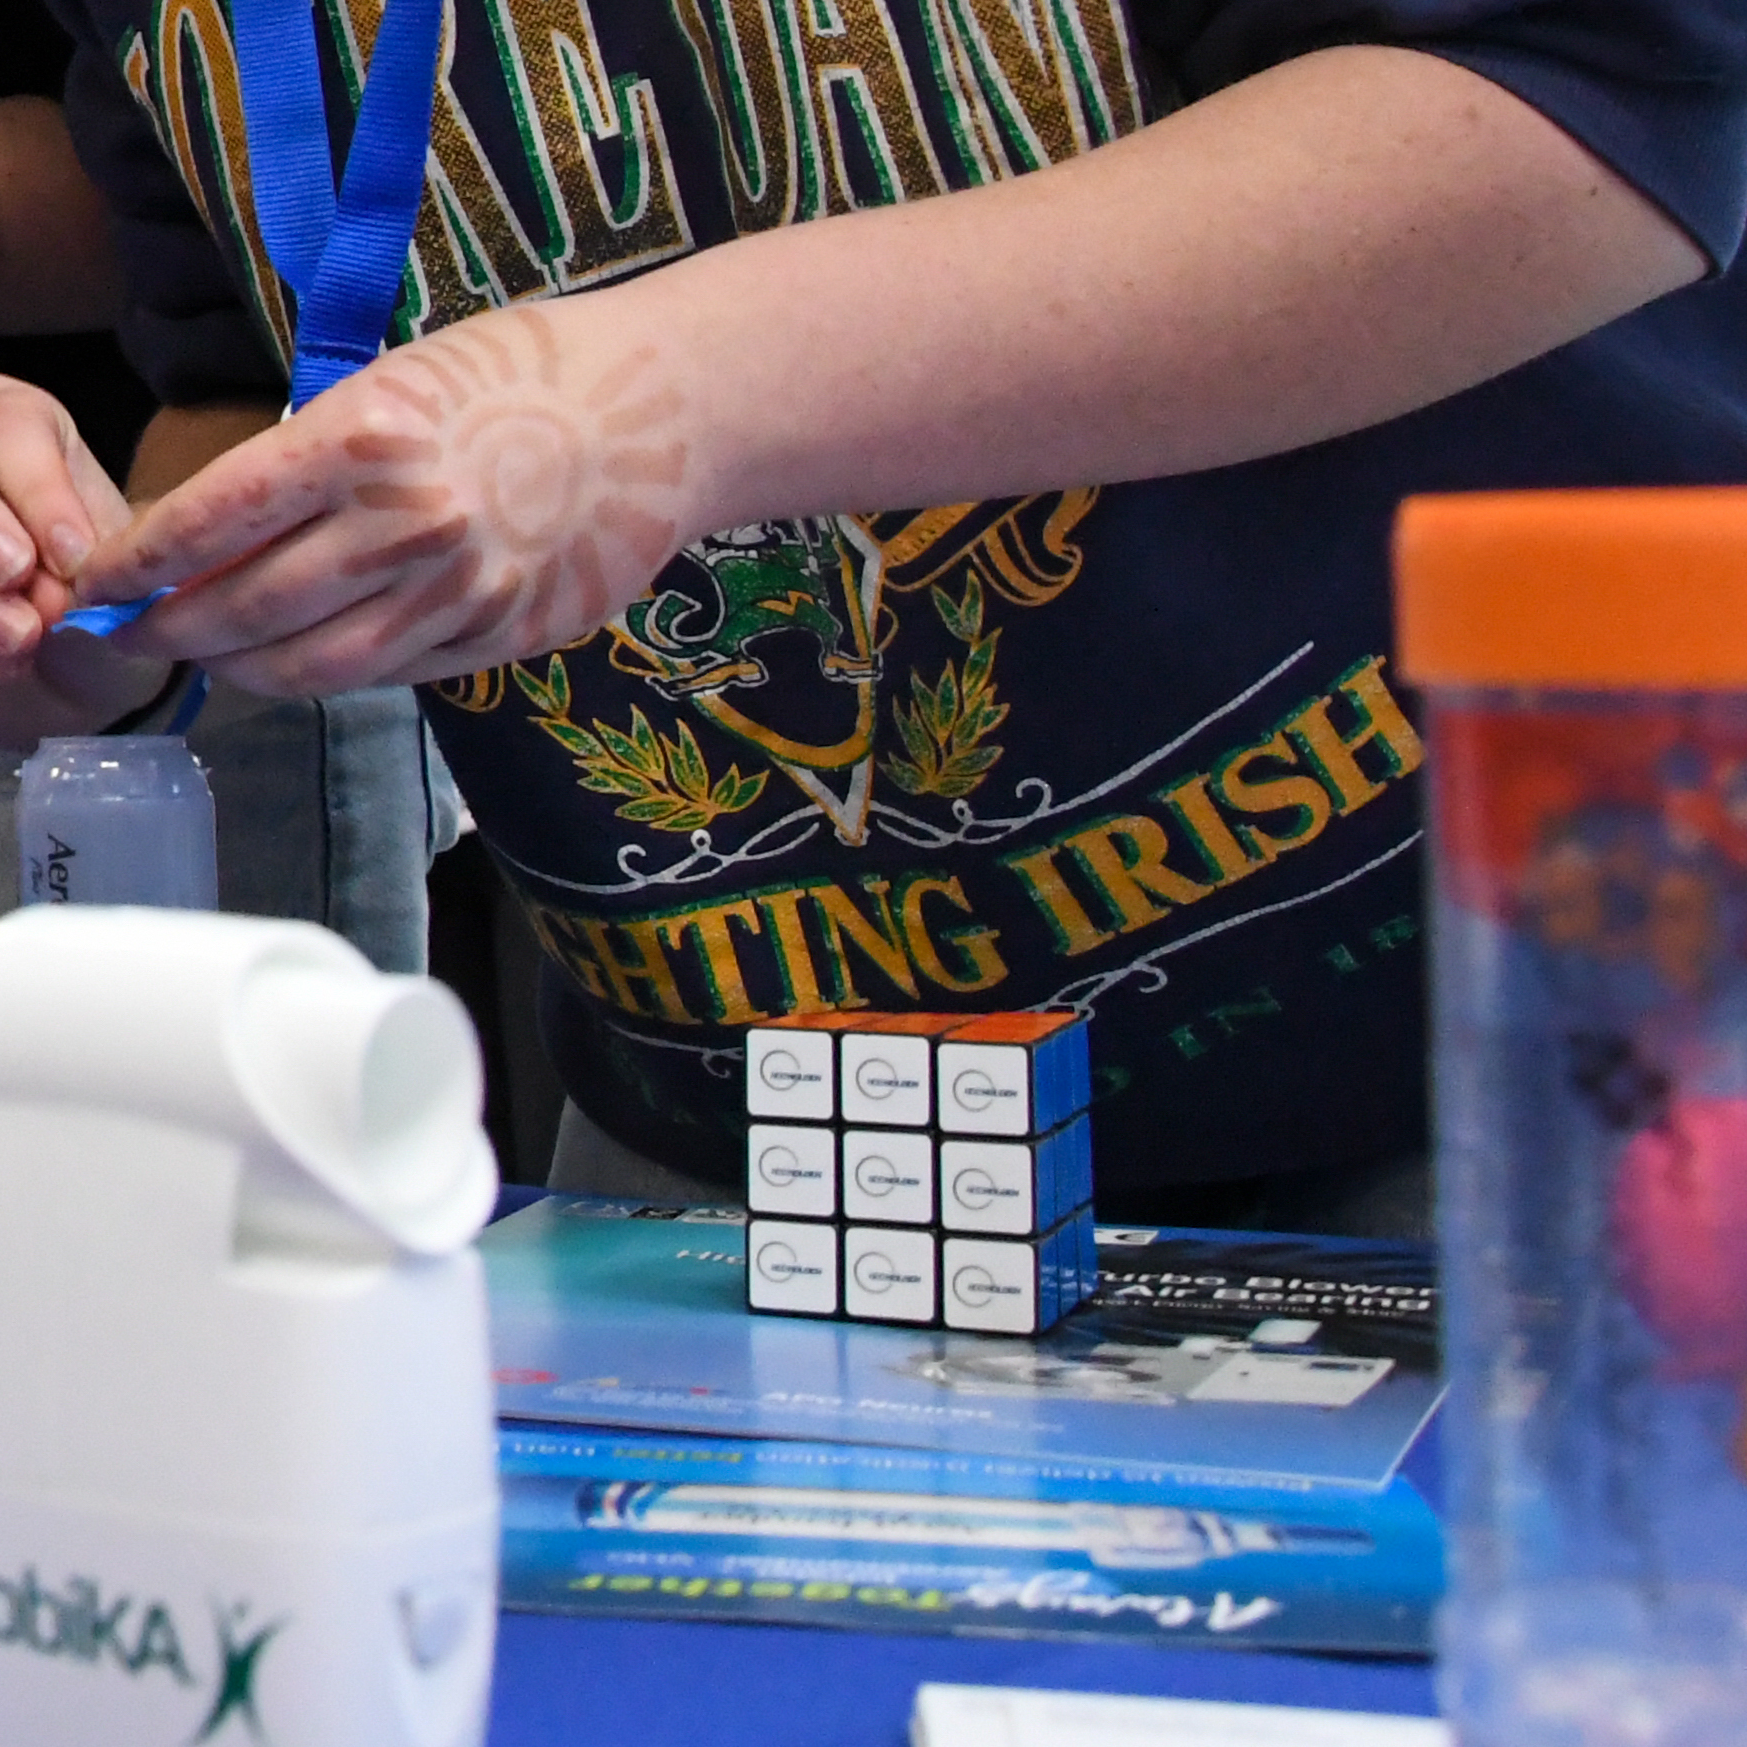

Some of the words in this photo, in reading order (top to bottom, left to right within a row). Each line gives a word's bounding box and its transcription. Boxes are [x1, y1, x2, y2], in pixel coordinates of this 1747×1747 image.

[1001, 654, 1427, 957] IRISH
[1114, 1284, 1198, 1300] Air
[1213, 1288, 1431, 1312] Bearing
[1246, 1276, 1441, 1297] Blower
